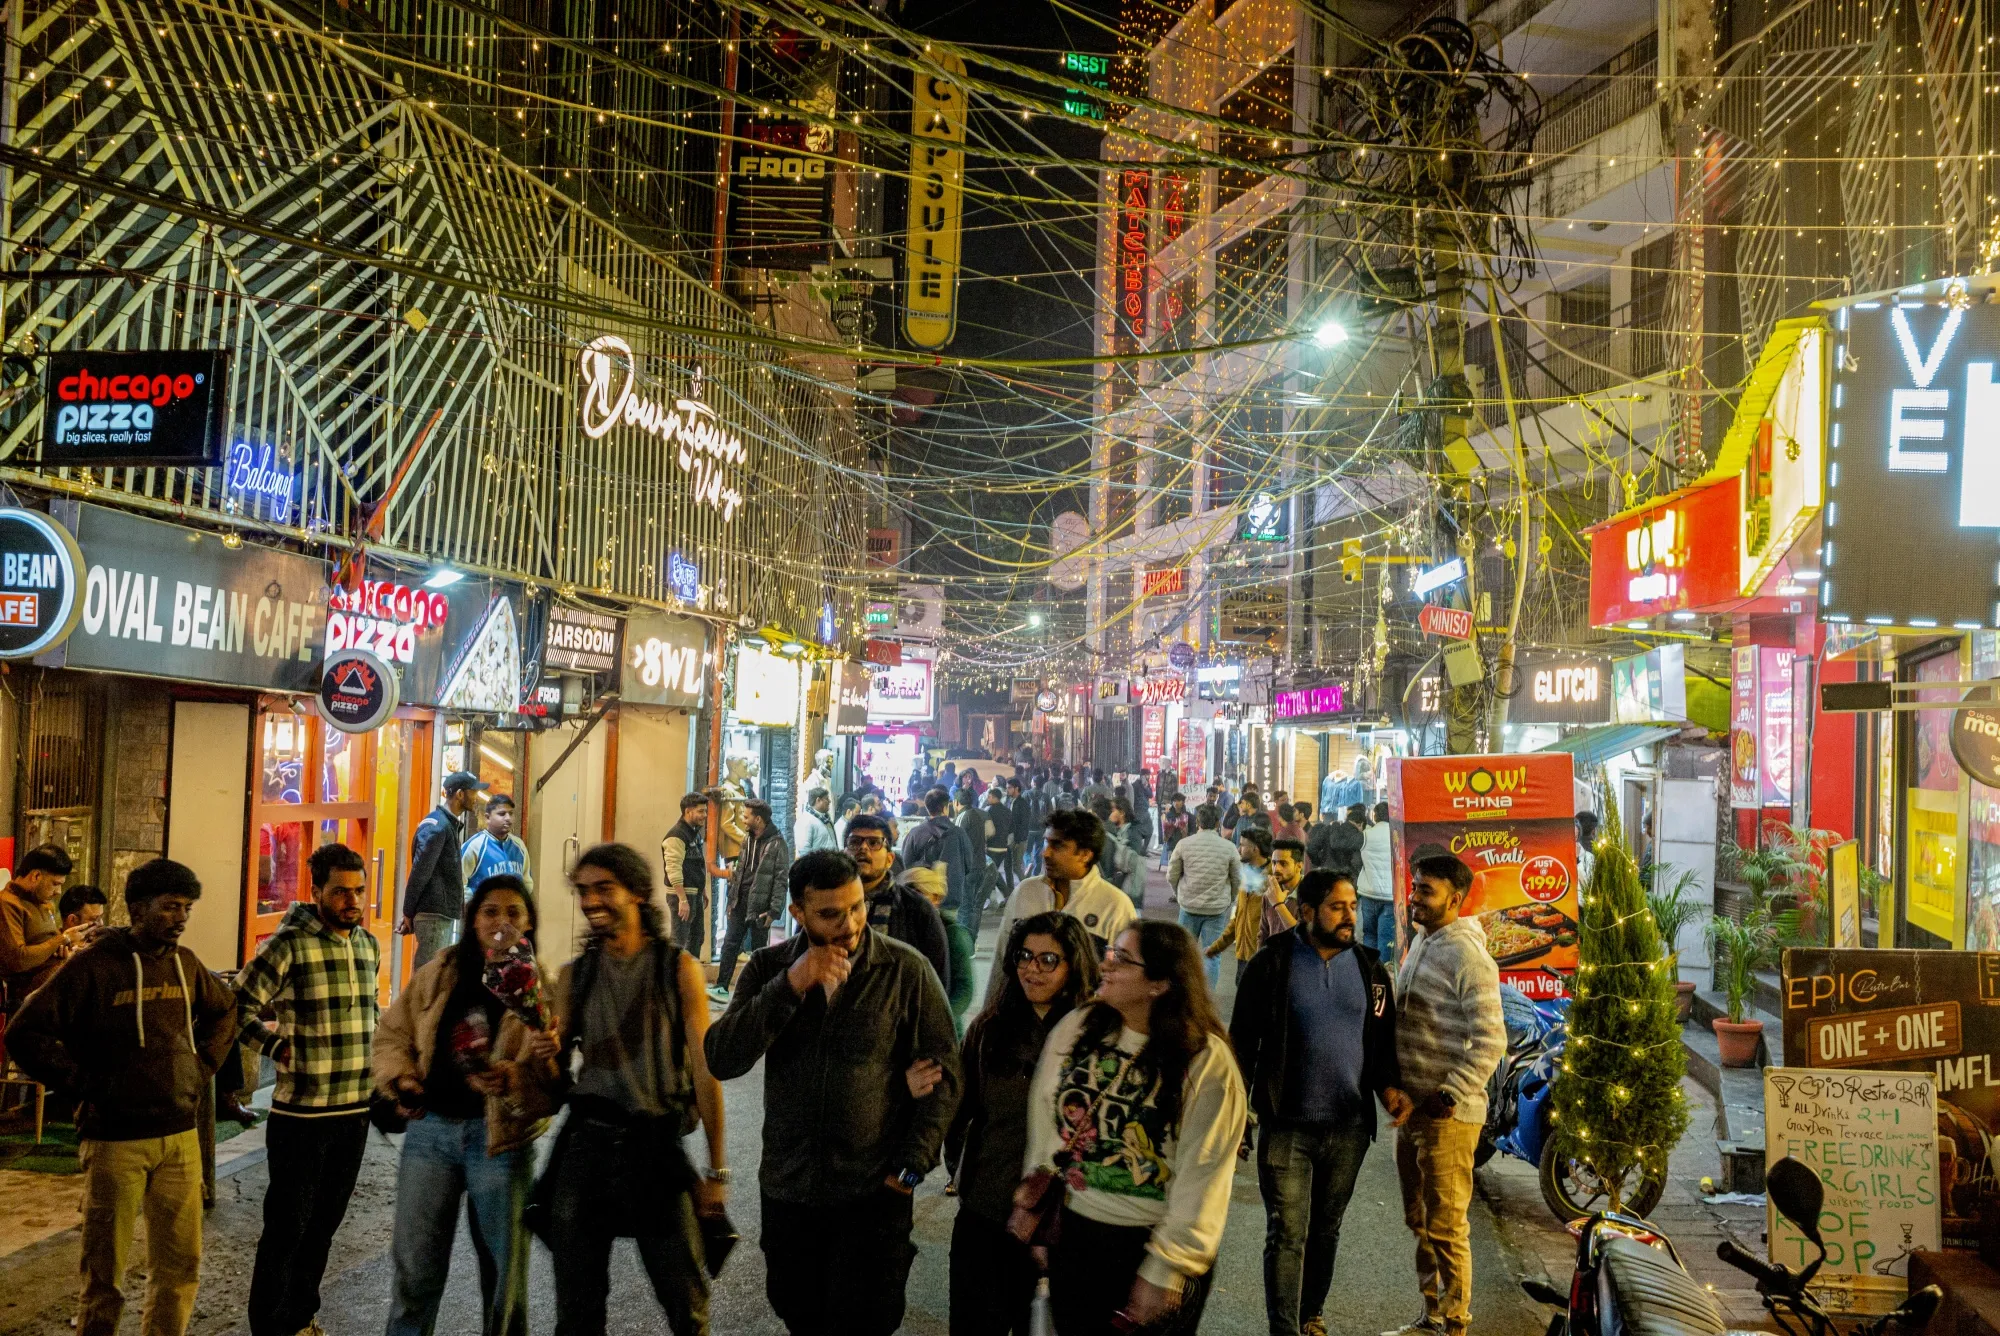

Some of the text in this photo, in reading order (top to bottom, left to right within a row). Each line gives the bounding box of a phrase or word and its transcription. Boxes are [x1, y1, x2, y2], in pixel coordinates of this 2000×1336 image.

[1067, 52, 1108, 75] BEST
[739, 156, 825, 178] FROG
[919, 77, 952, 298] CAPSULE
[58, 368, 195, 407] chicago
[56, 403, 154, 444] pizza
[66, 430, 152, 445] big slices, really fast
[230, 442, 295, 521] Balcony
[4, 553, 57, 589] BEAN
[82, 564, 317, 662] OVAL BEAN CAFÉ
[1428, 610, 1469, 636] MINISO
[323, 612, 416, 664] pizza
[548, 621, 615, 655] BARSOOM
[331, 692, 369, 706] chicago
[538, 686, 560, 704] FROG
[1534, 666, 1599, 704] GLITCH
[331, 701, 359, 711] pizza
[1964, 716, 2000, 738] ma
[1444, 765, 1529, 797] WOW!
[1450, 835, 1521, 855] Chinese
[1476, 849, 1527, 867] Thali
[1533, 859, 1553, 868] JUST
[1507, 976, 1563, 996] Non Veg
[1788, 969, 1878, 1009] EPIC
[1819, 1010, 1946, 1061] ONE + ONE
[1794, 1102, 1811, 1115] ALL
[1860, 1143, 1931, 1172] DRINKS
[1776, 1208, 1870, 1237] ROF
[1785, 1236, 1876, 1274] TOP
